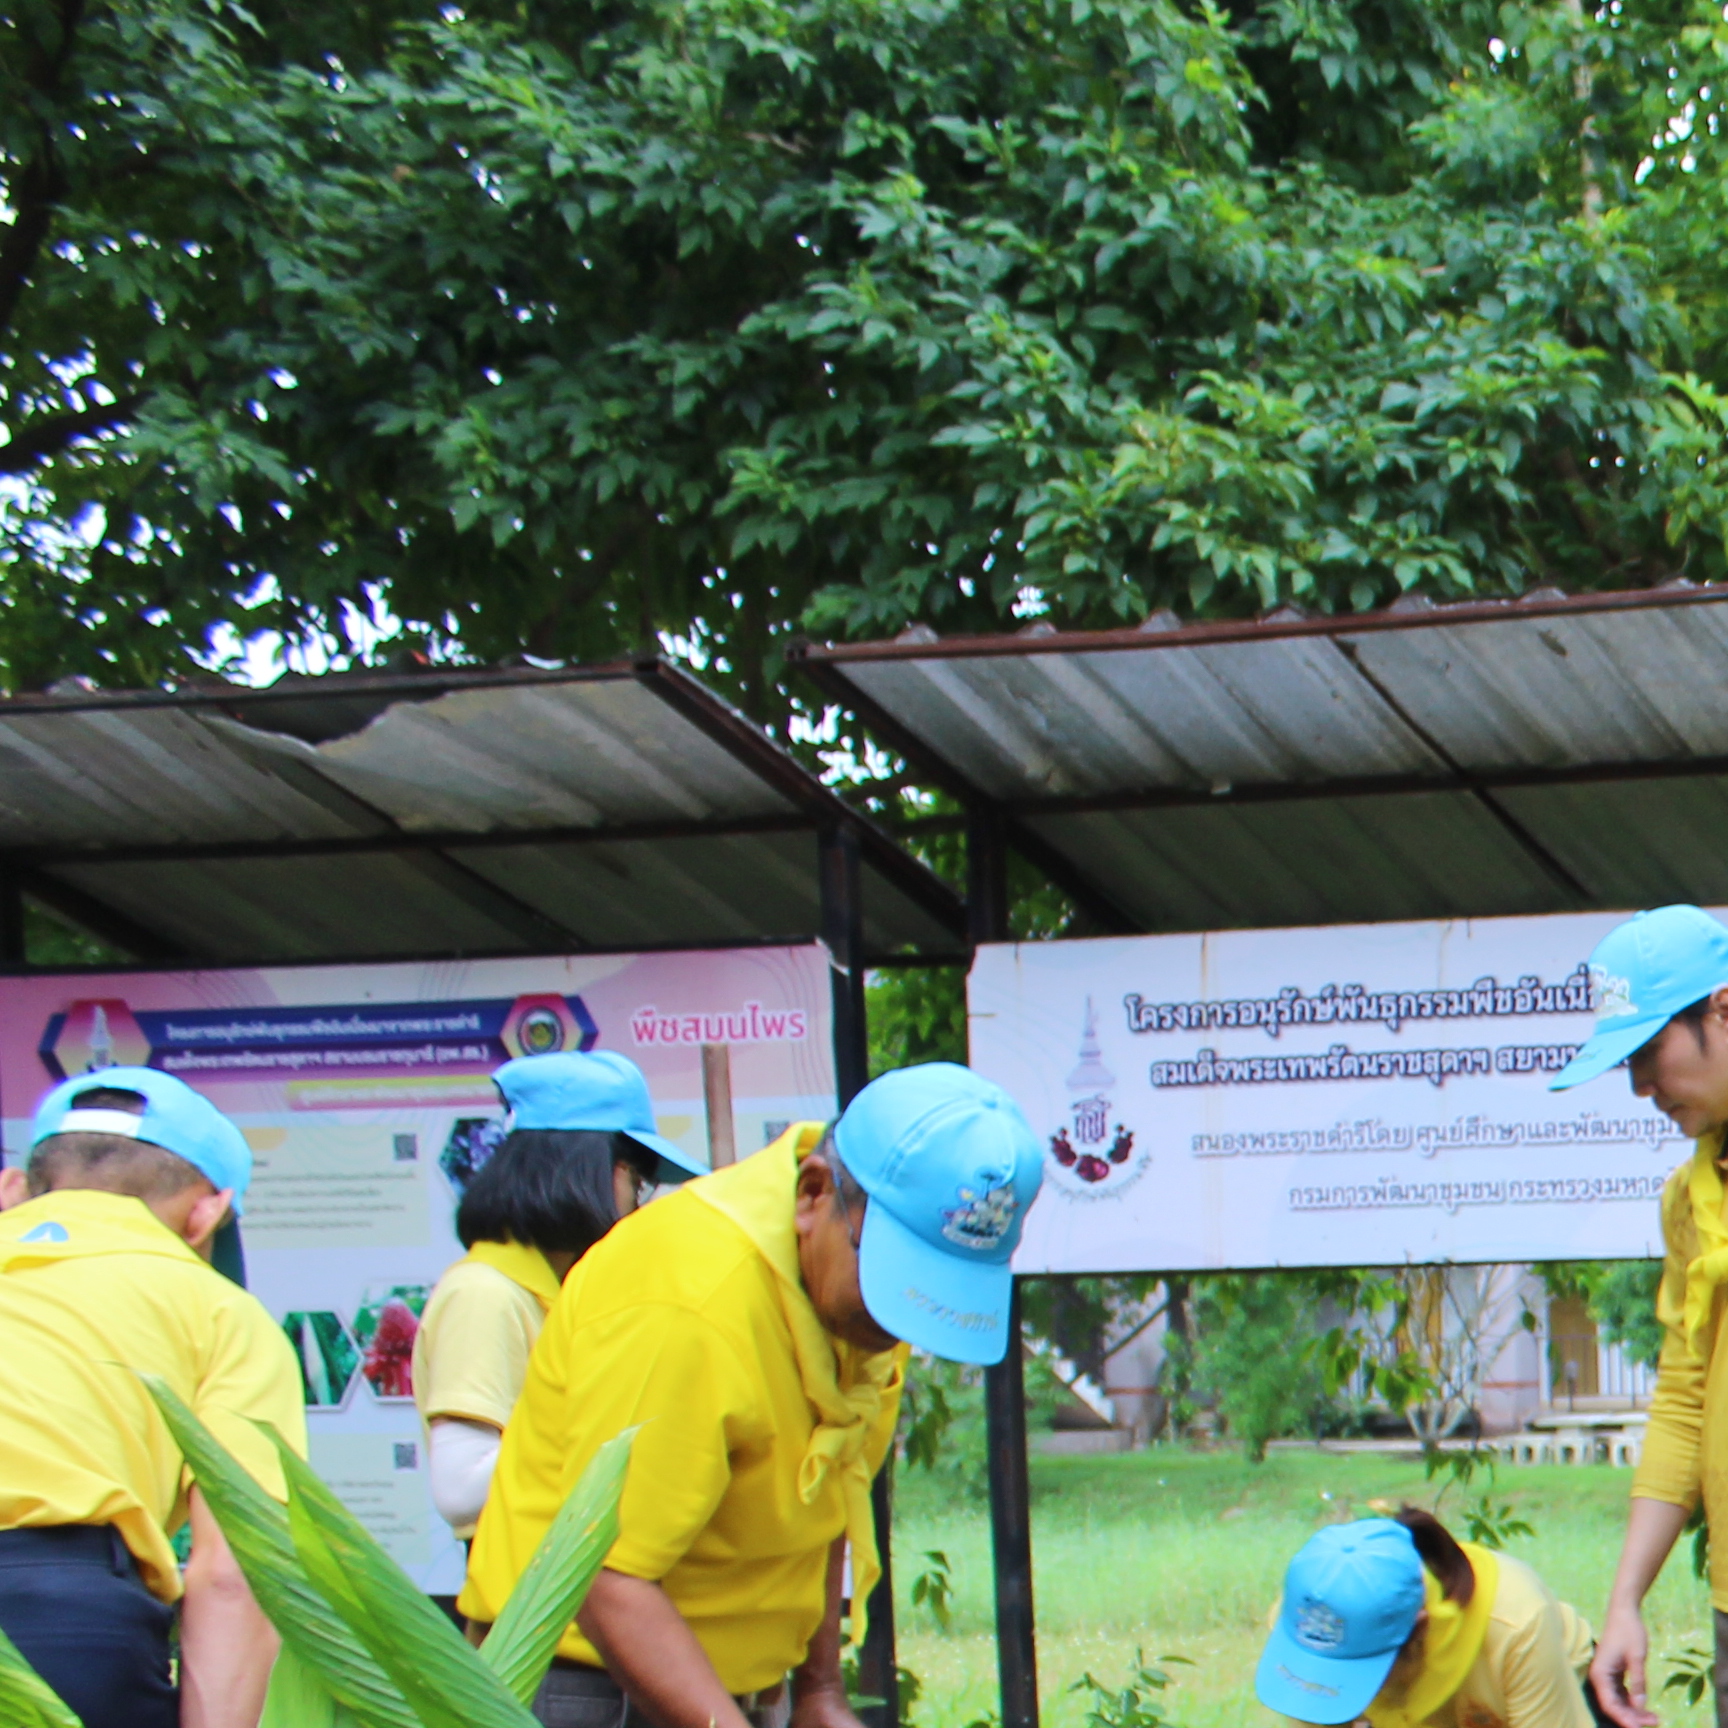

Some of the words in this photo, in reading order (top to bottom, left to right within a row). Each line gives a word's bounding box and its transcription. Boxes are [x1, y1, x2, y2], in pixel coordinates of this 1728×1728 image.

[1150, 1044, 1488, 1088] สมเด็จพระเทพรัตนราชสุดาฯ
